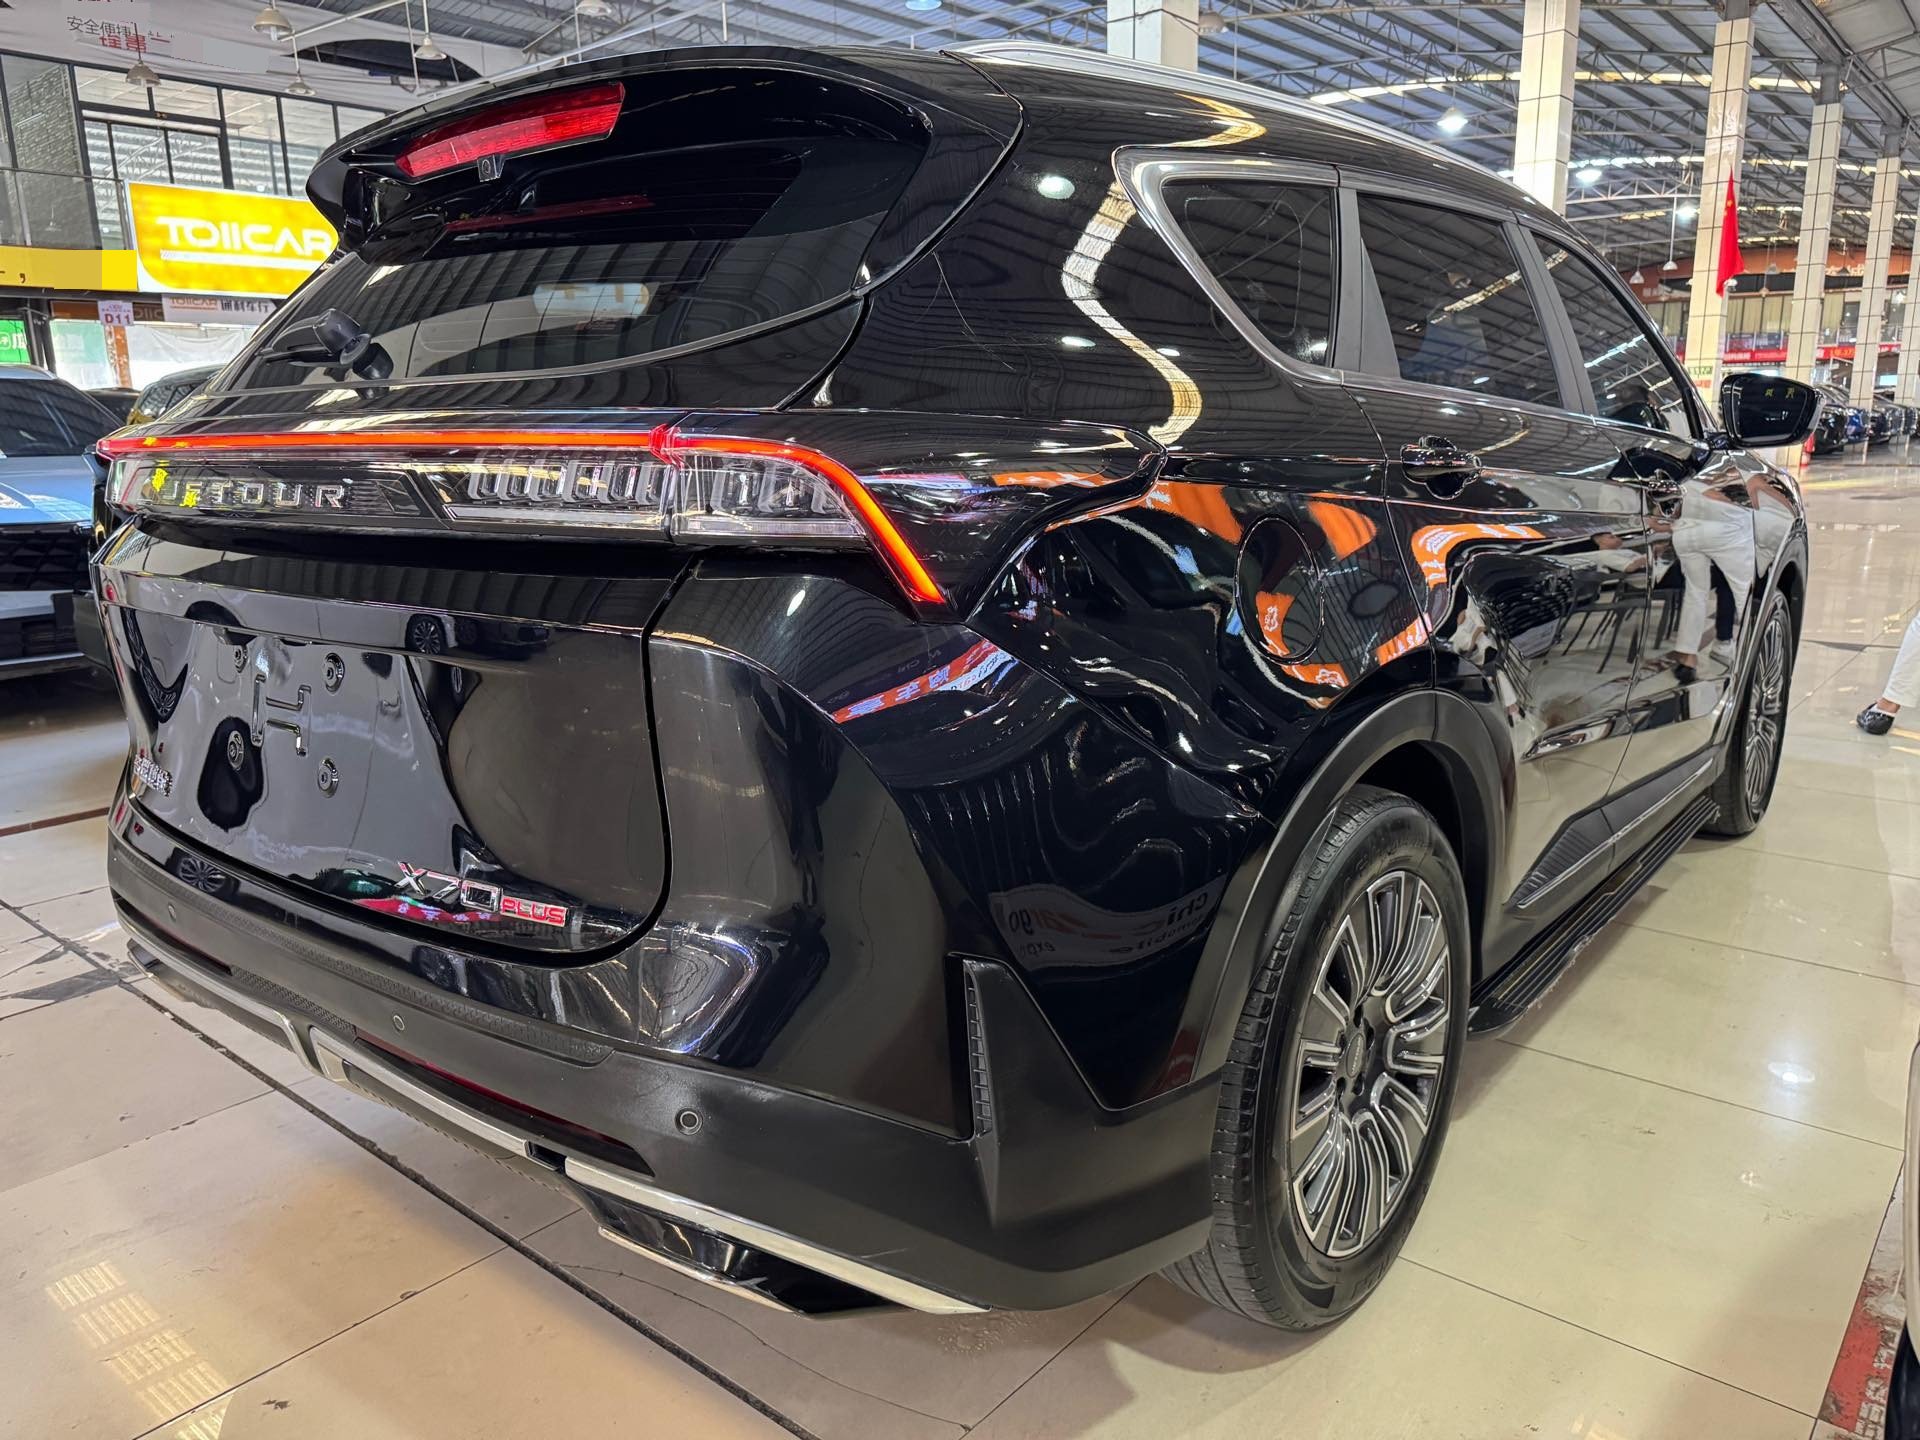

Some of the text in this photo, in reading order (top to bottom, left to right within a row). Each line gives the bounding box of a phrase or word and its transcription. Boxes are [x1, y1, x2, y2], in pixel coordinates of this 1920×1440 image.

[104, 313, 131, 325] D11
[394, 861, 568, 927] X70 PLUS
